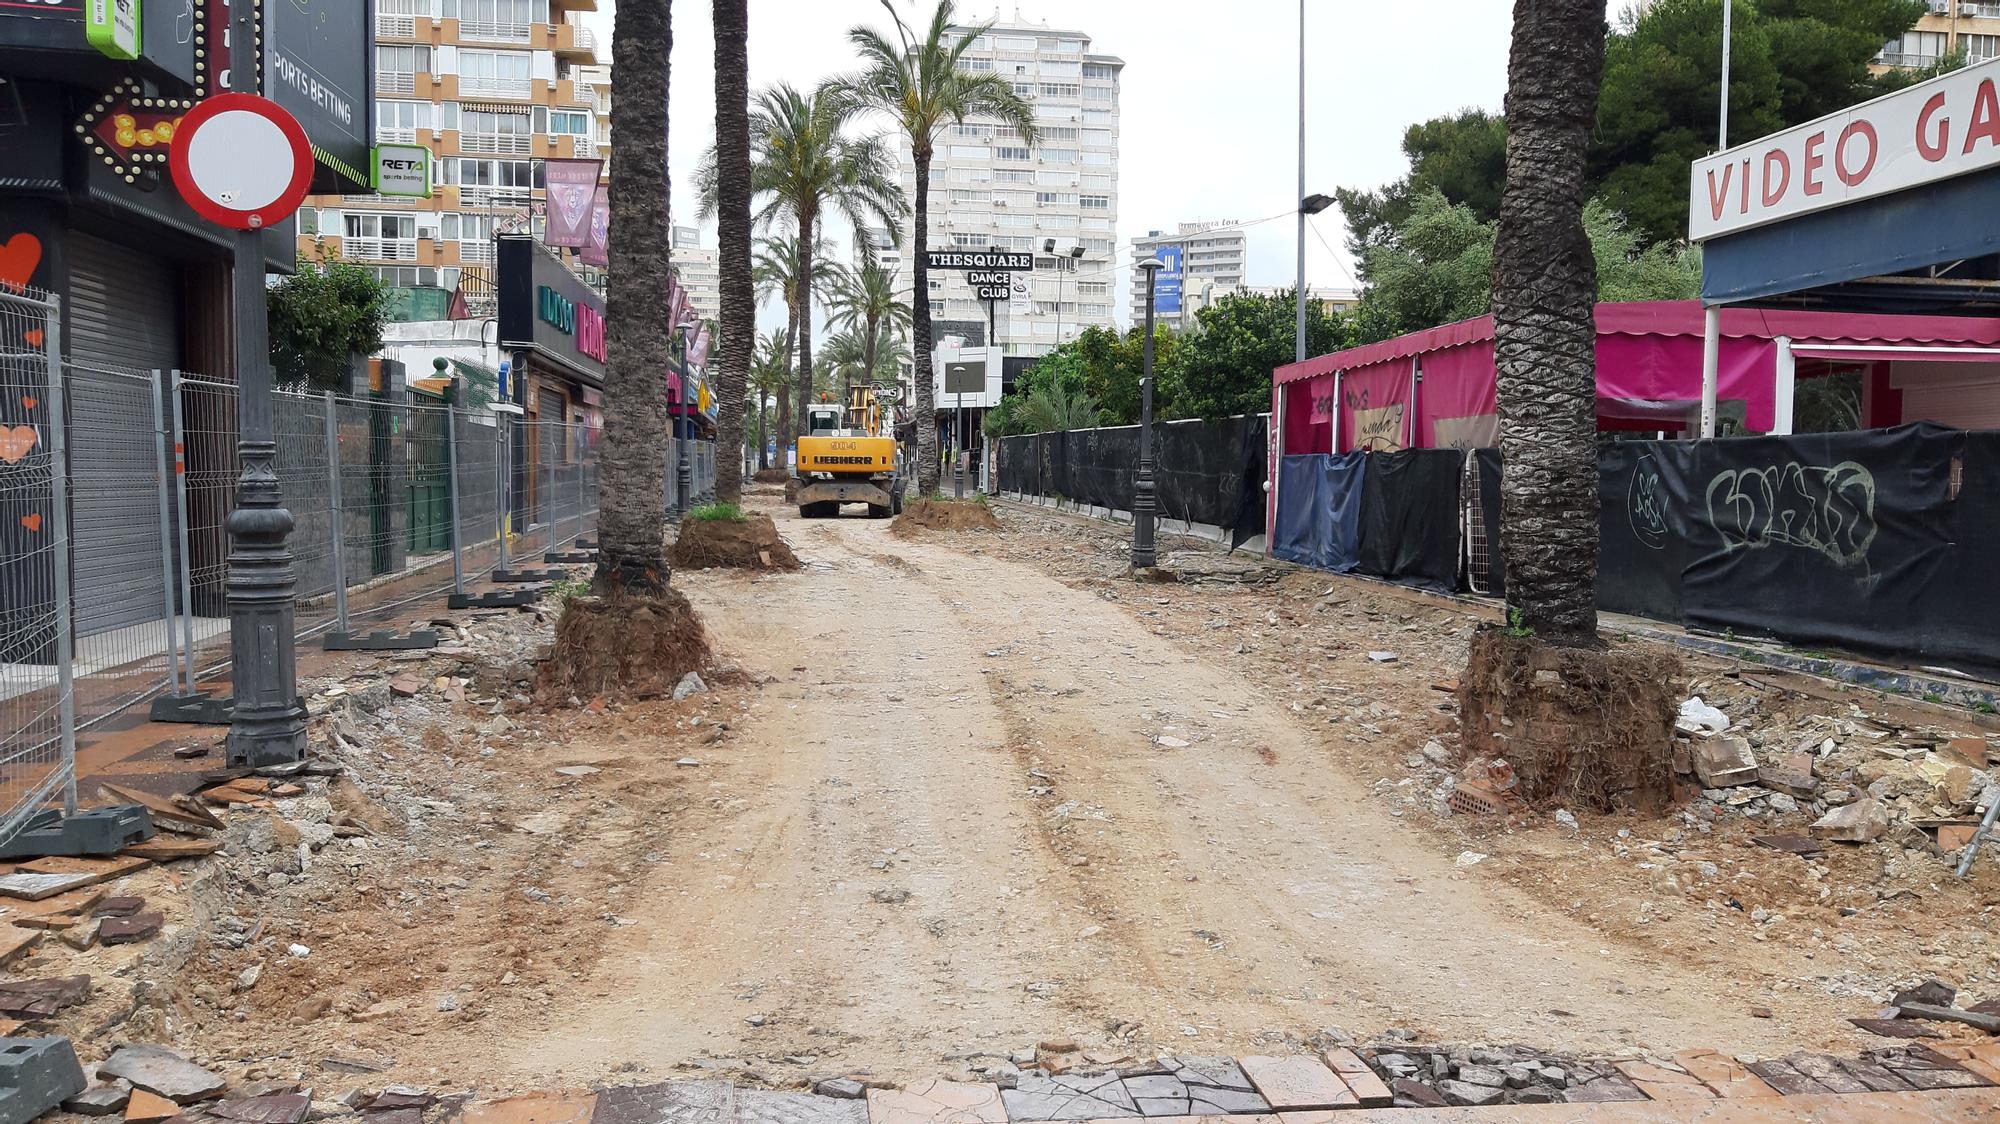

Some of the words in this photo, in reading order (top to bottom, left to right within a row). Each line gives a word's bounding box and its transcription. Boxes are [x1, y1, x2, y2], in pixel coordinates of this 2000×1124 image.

[310, 78, 351, 125] BETTING
[382, 159, 423, 173] RETA
[1706, 119, 1878, 222] VIDEO
[971, 272, 1009, 284] DANCE
[980, 287, 1009, 298] CLUB
[813, 456, 873, 465] LIEBHERR
